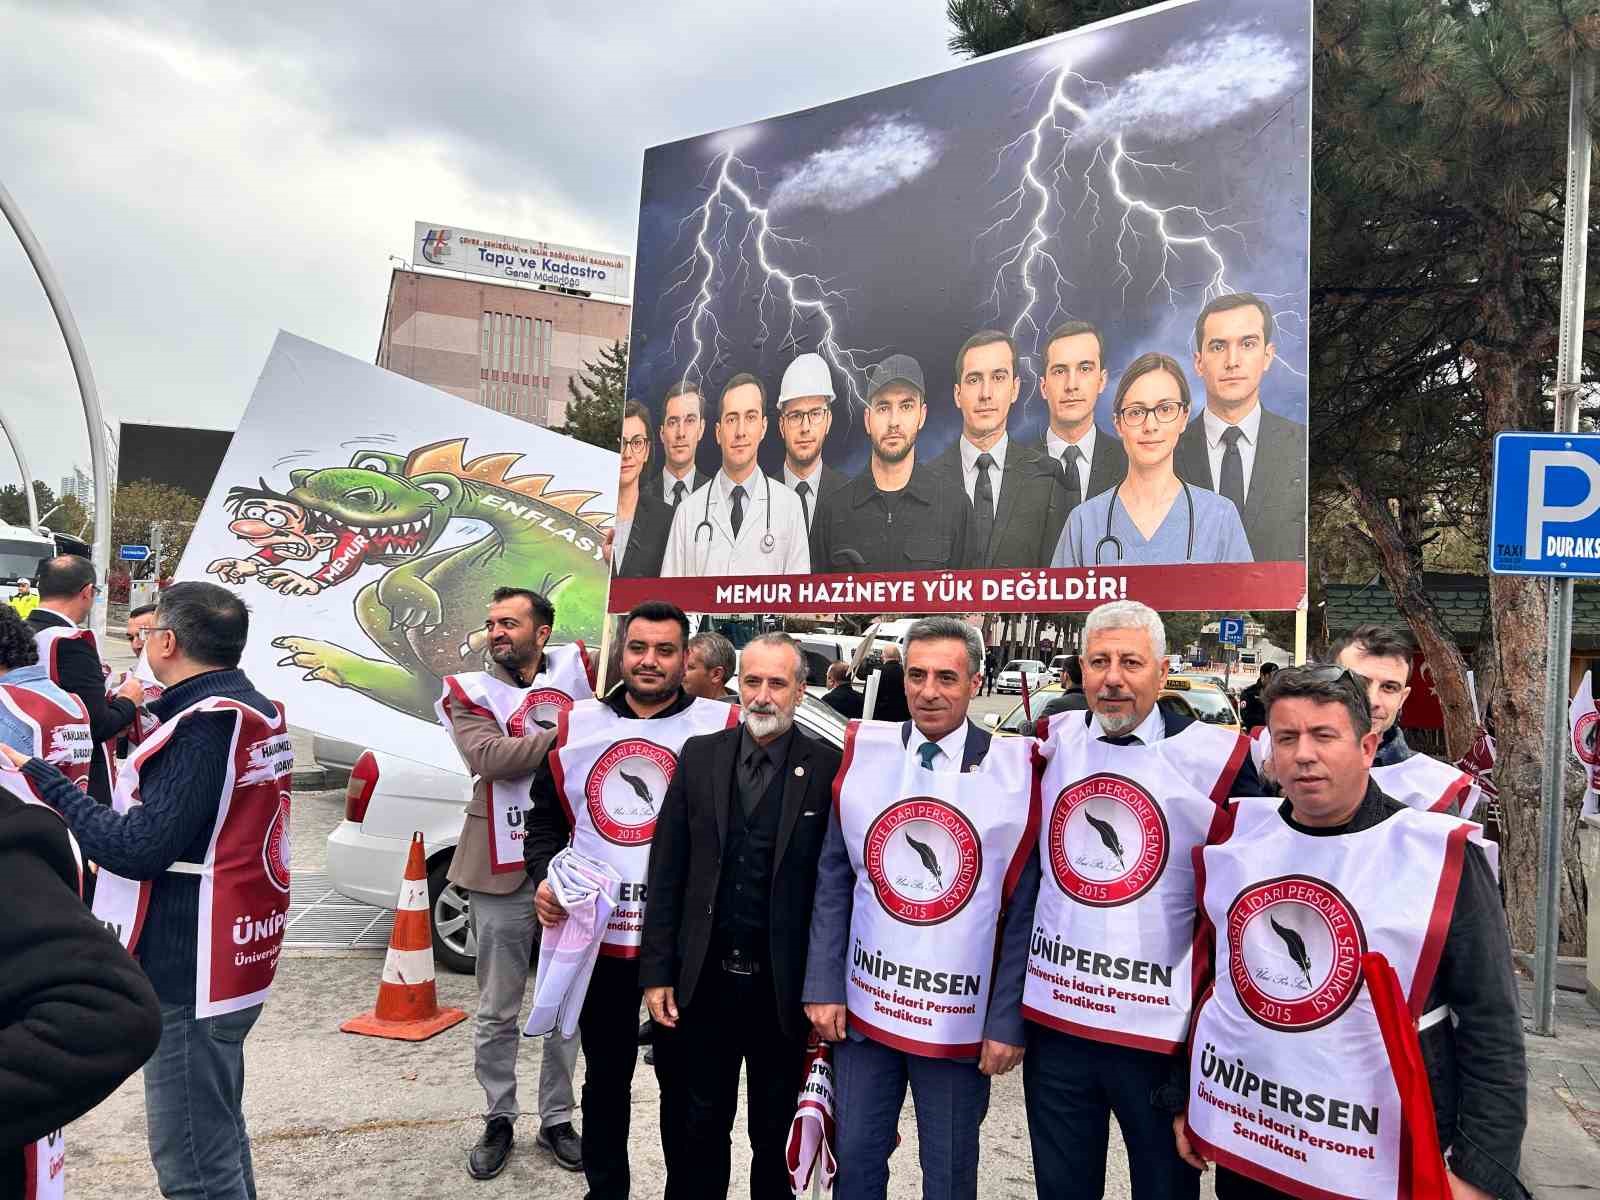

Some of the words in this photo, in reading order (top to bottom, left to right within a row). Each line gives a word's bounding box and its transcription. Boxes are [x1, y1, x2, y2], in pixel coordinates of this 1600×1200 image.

[479, 248, 515, 268] Tapu
[520, 257, 537, 269] ve
[542, 259, 607, 280] Kadastro
[505, 266, 531, 280] Genel
[1525, 450, 1600, 560] P
[323, 534, 370, 582] MEMUR
[716, 583, 792, 604] MEMUR
[799, 575, 915, 603] HAZİNEYE
[921, 573, 975, 602] YÜK
[982, 569, 1128, 601] DEĞİLDİR!
[1098, 782, 1154, 824] PERSONEL
[617, 829, 641, 840] 2015
[918, 805, 969, 847] PERSONEL
[898, 903, 927, 918] 2015
[1077, 883, 1109, 899] 2015
[1288, 885, 1348, 934] PERSONEL
[853, 937, 981, 996] ÜNİPERSEN
[1030, 926, 1173, 988] ÜNİPERSEN
[892, 989, 924, 1011] İdari
[926, 1000, 976, 1015] Personel
[1027, 959, 1071, 988] Üniversite
[1072, 975, 1105, 997] İdari
[1107, 986, 1171, 1007] Personel
[1052, 988, 1117, 1015] Sendikası
[874, 1001, 934, 1027] Sendikası
[1258, 1001, 1293, 1022] 2015
[1200, 1041, 1380, 1136] ÜNİPERSEN
[1197, 1080, 1256, 1123] Üniversite
[1258, 1108, 1296, 1139] İdari
[1298, 1129, 1376, 1160] Personel
[1232, 1121, 1308, 1163] Sendikası
